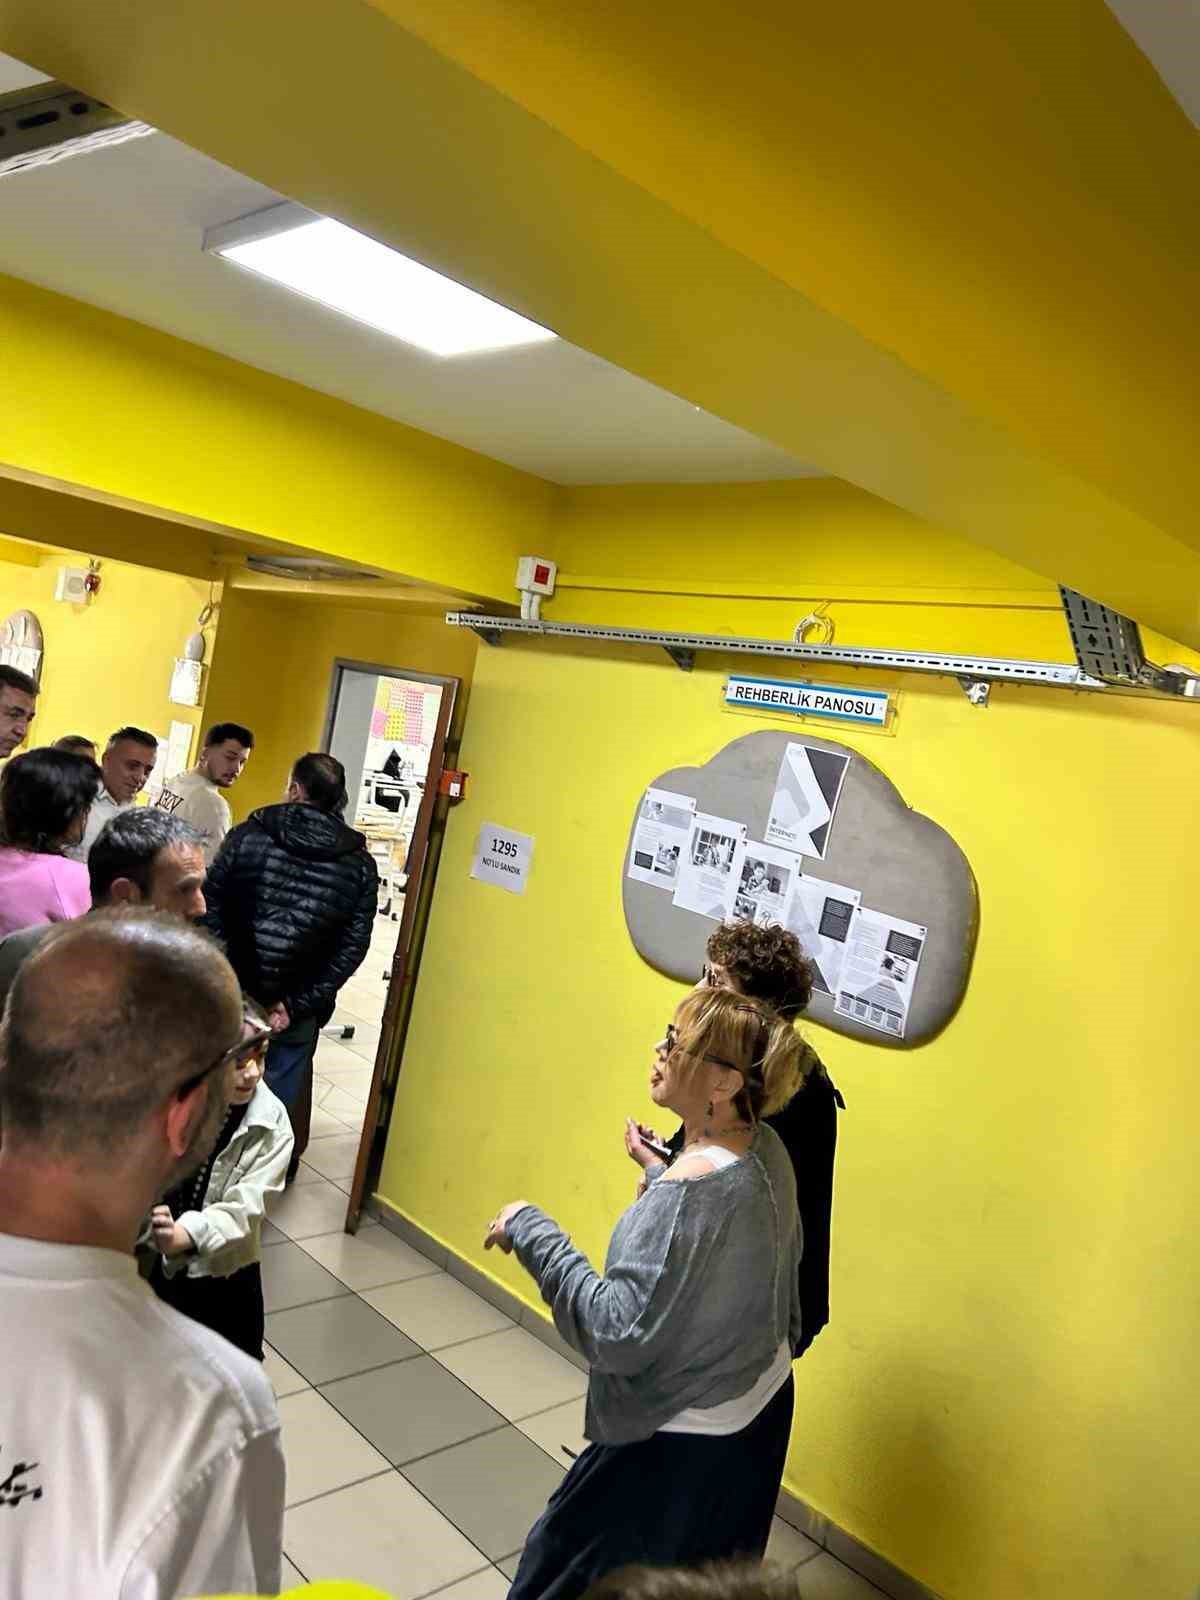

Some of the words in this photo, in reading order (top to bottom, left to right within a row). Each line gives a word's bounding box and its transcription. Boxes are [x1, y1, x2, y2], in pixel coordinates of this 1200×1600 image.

[736, 686, 809, 706] REHBERLİK
[814, 696, 875, 715] PANOSU
[491, 838, 518, 857] 1295
